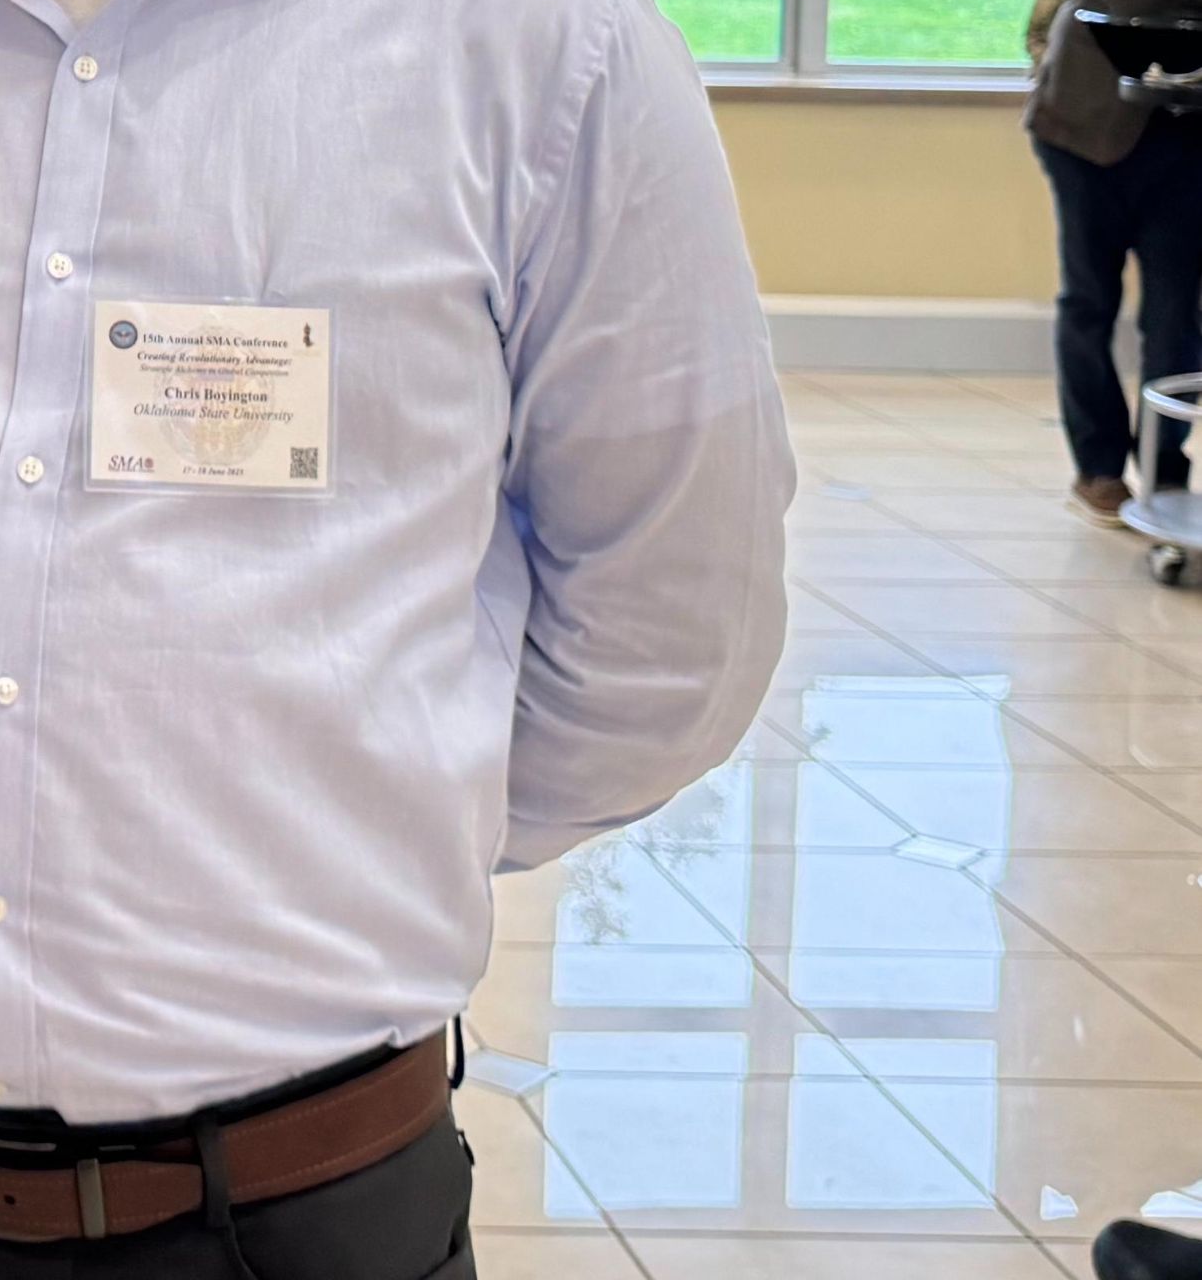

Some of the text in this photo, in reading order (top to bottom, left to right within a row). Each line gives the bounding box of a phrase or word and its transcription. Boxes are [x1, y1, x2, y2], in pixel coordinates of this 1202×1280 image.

[143, 333, 288, 349] 15th Annual SMA Conference
[164, 386, 268, 405] Chris Boyington
[133, 402, 293, 424] Oklahoma State University
[109, 454, 143, 471] SMA
